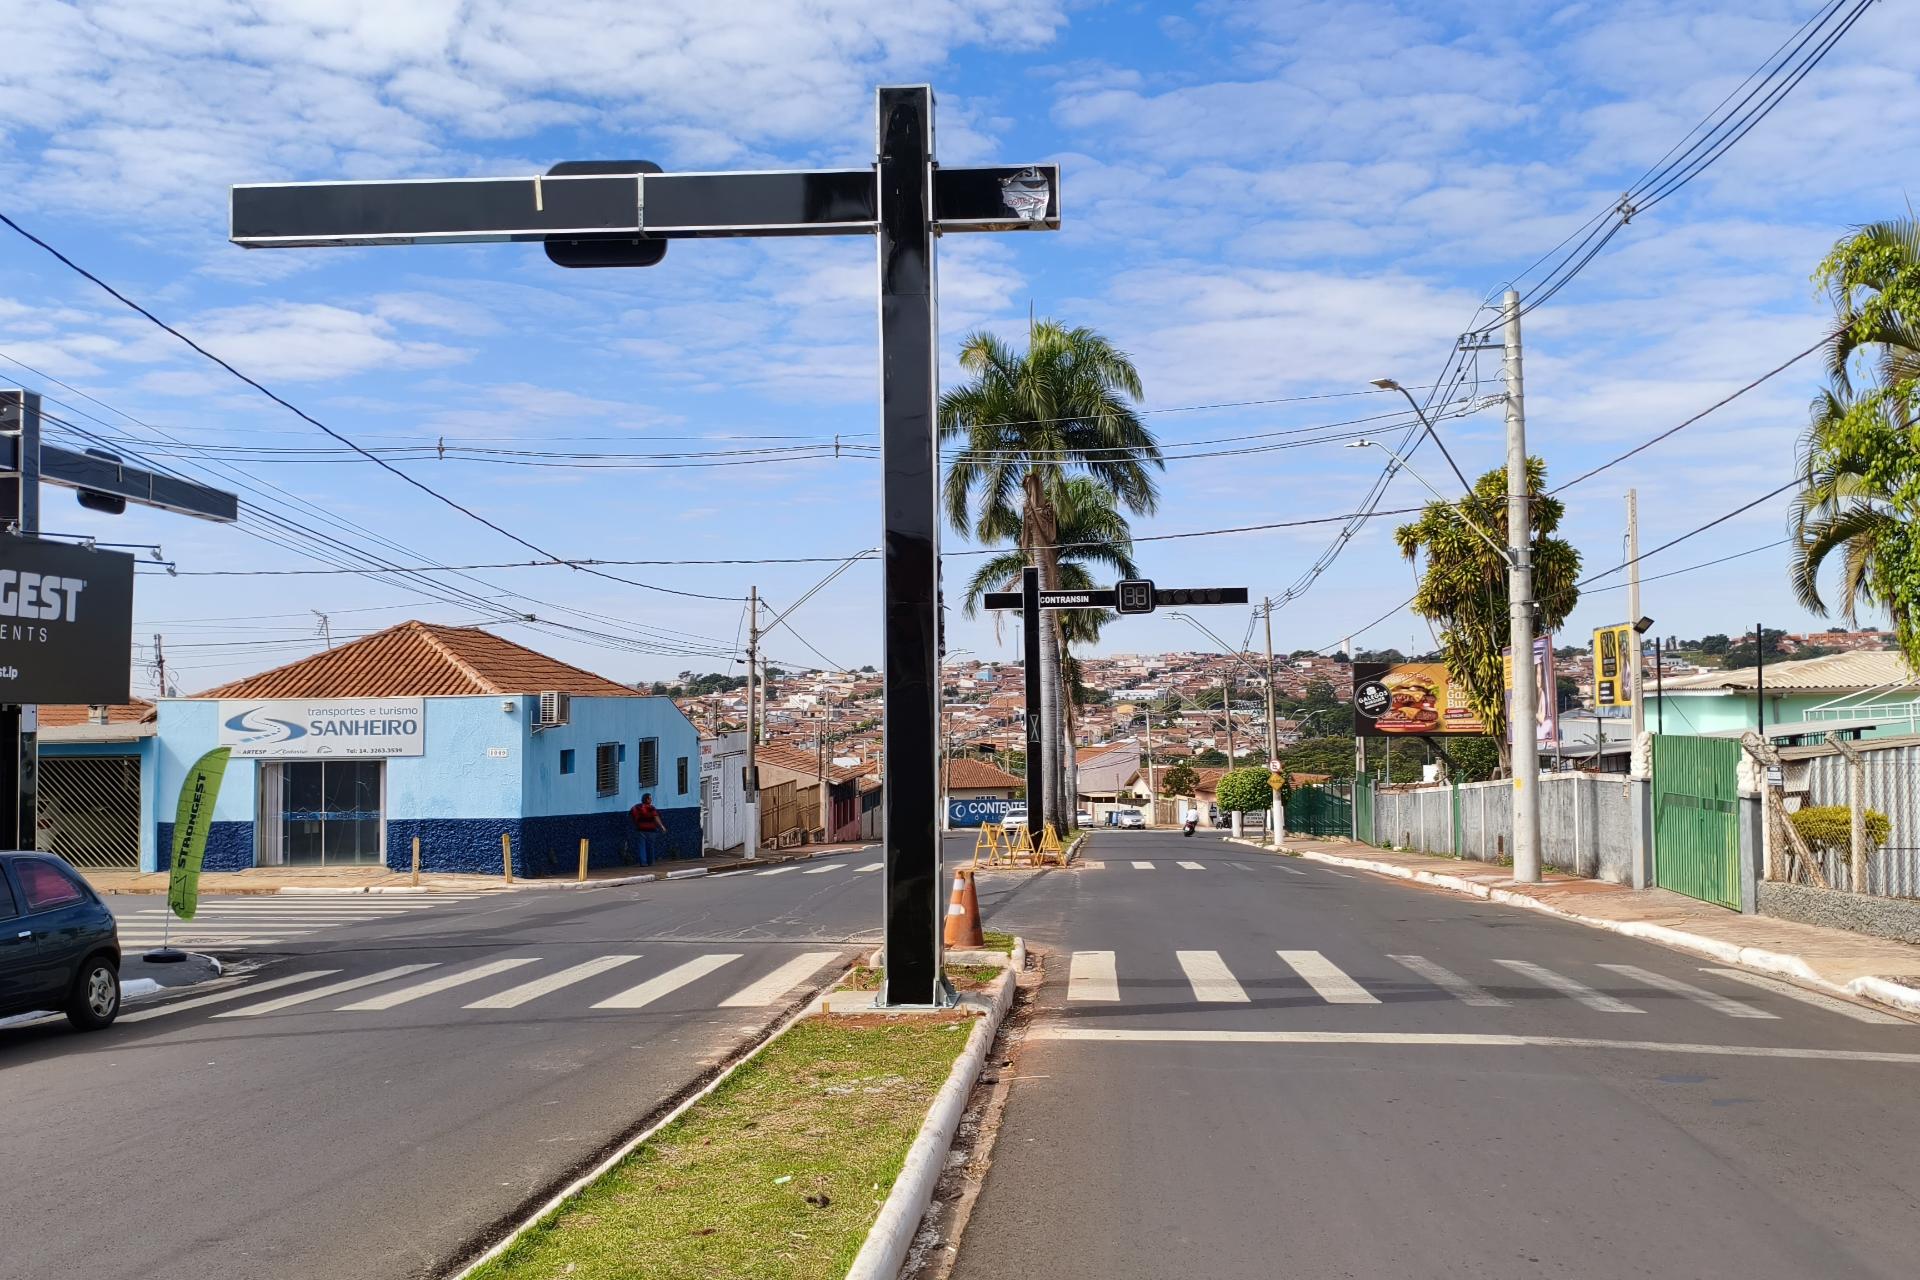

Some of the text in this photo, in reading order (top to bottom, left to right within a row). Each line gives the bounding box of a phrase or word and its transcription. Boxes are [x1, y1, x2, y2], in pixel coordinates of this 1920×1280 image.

[1040, 595, 1089, 604] CONTRANSIN
[0, 624, 48, 643] ENTS
[1358, 690, 1388, 704] GALEGOS
[307, 707, 366, 718] transportes
[379, 706, 418, 715] turismo
[310, 719, 418, 736] SANHEIRO
[968, 801, 1026, 814] CONTENTE
[177, 772, 206, 870] STRONGEST
